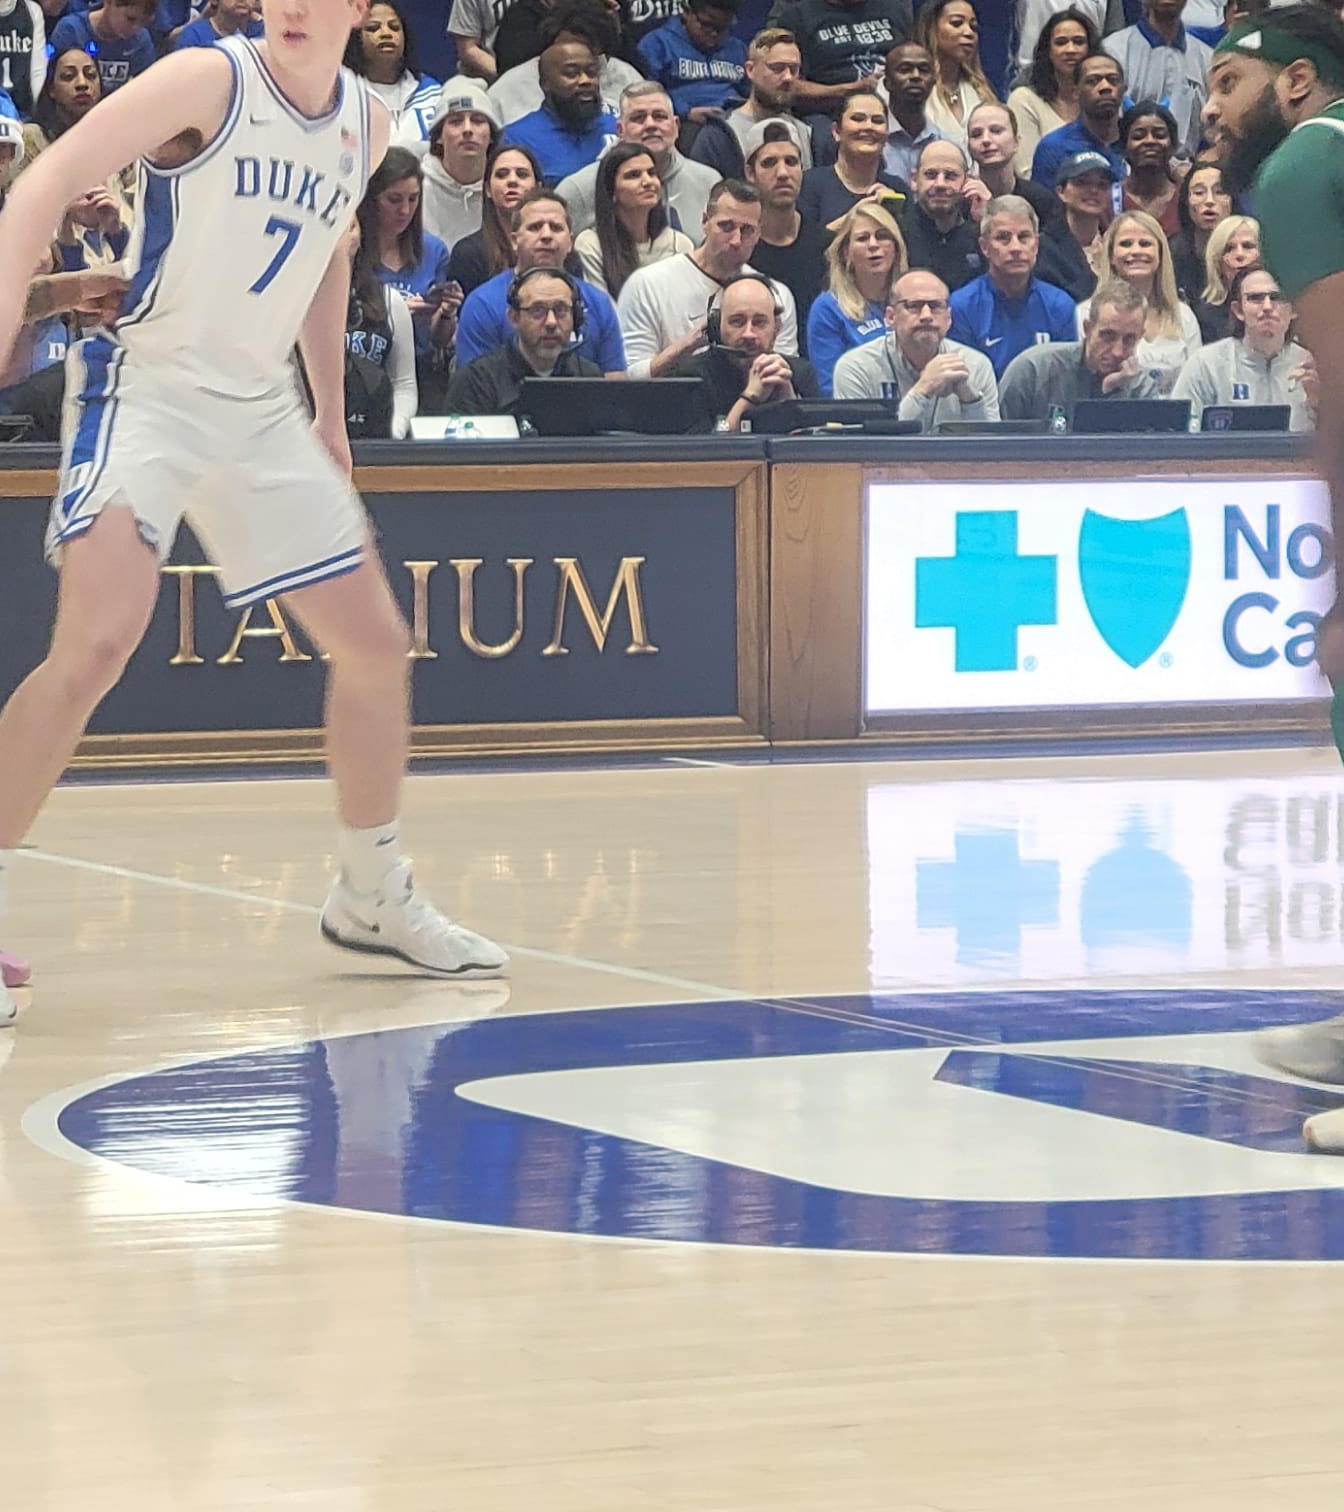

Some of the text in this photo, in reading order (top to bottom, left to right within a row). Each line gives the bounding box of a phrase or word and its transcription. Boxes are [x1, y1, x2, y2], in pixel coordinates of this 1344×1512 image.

[817, 19, 891, 42] BLUE DEVILS
[1, 57, 12, 87] 1
[232, 154, 352, 229] DUKE
[246, 213, 304, 297] 7
